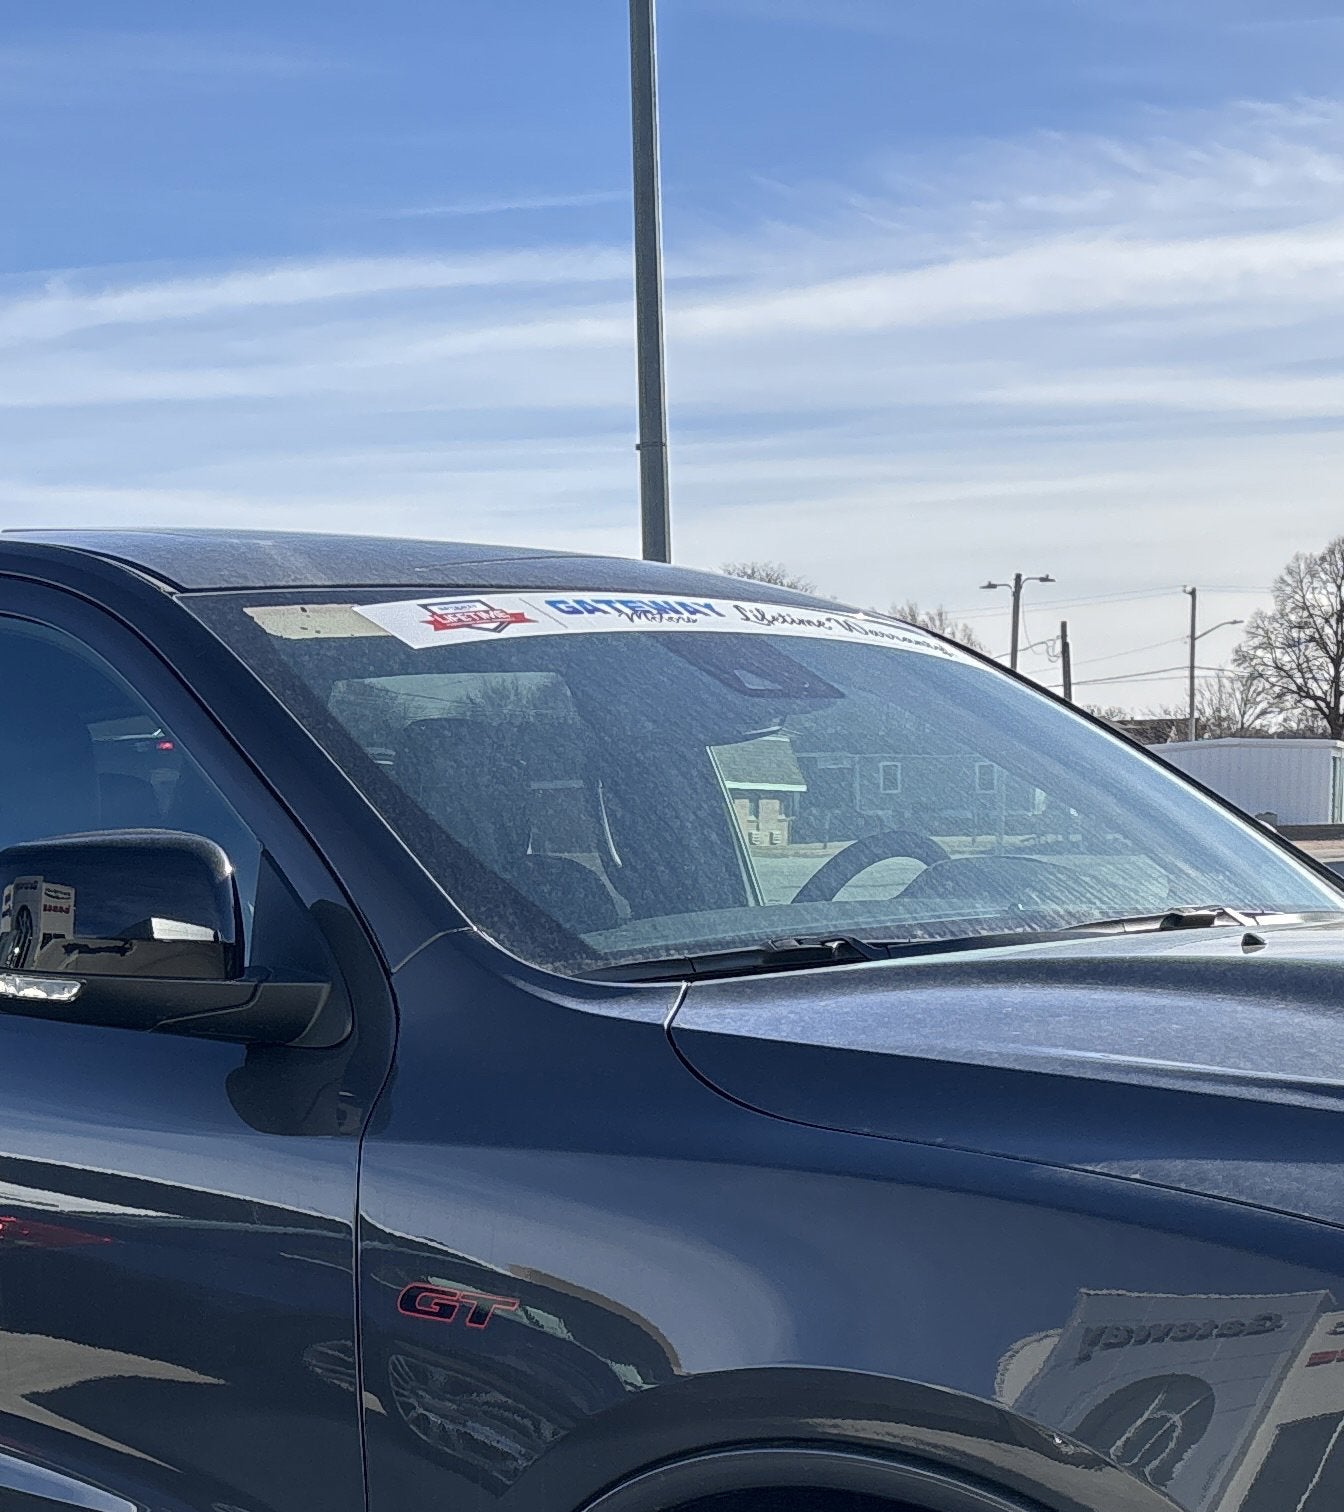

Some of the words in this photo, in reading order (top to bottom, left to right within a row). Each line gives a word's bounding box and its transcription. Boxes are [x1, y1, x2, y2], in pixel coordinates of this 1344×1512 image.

[544, 599, 726, 618] GATEWAY
[732, 604, 834, 632] Lifetime
[396, 1283, 520, 1329] GT
